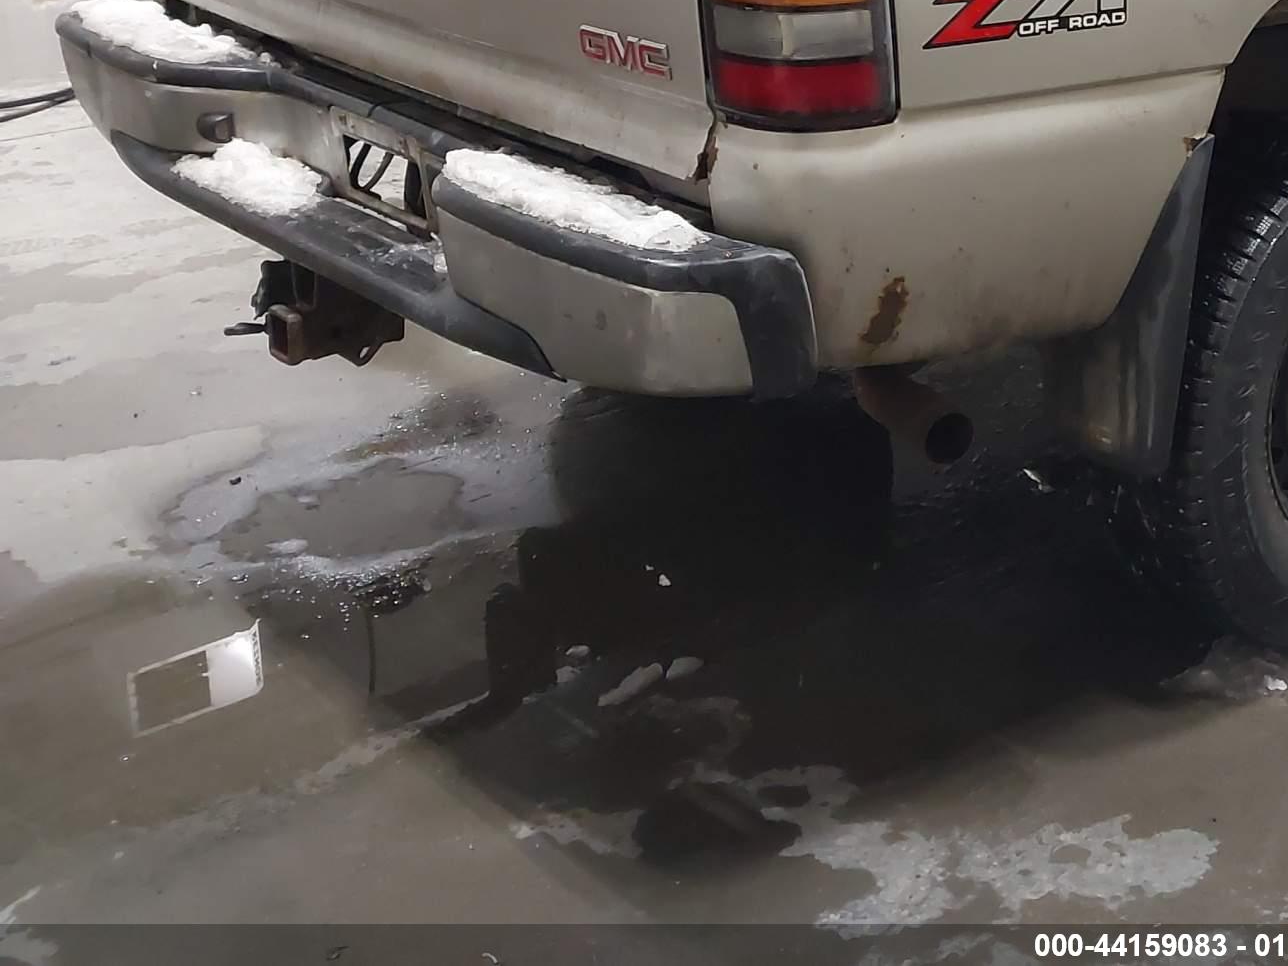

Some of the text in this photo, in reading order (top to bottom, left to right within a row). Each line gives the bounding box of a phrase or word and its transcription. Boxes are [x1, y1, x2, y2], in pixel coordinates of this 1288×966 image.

[1018, 11, 1126, 37] OFF ROAD
[577, 24, 673, 80] GMC
